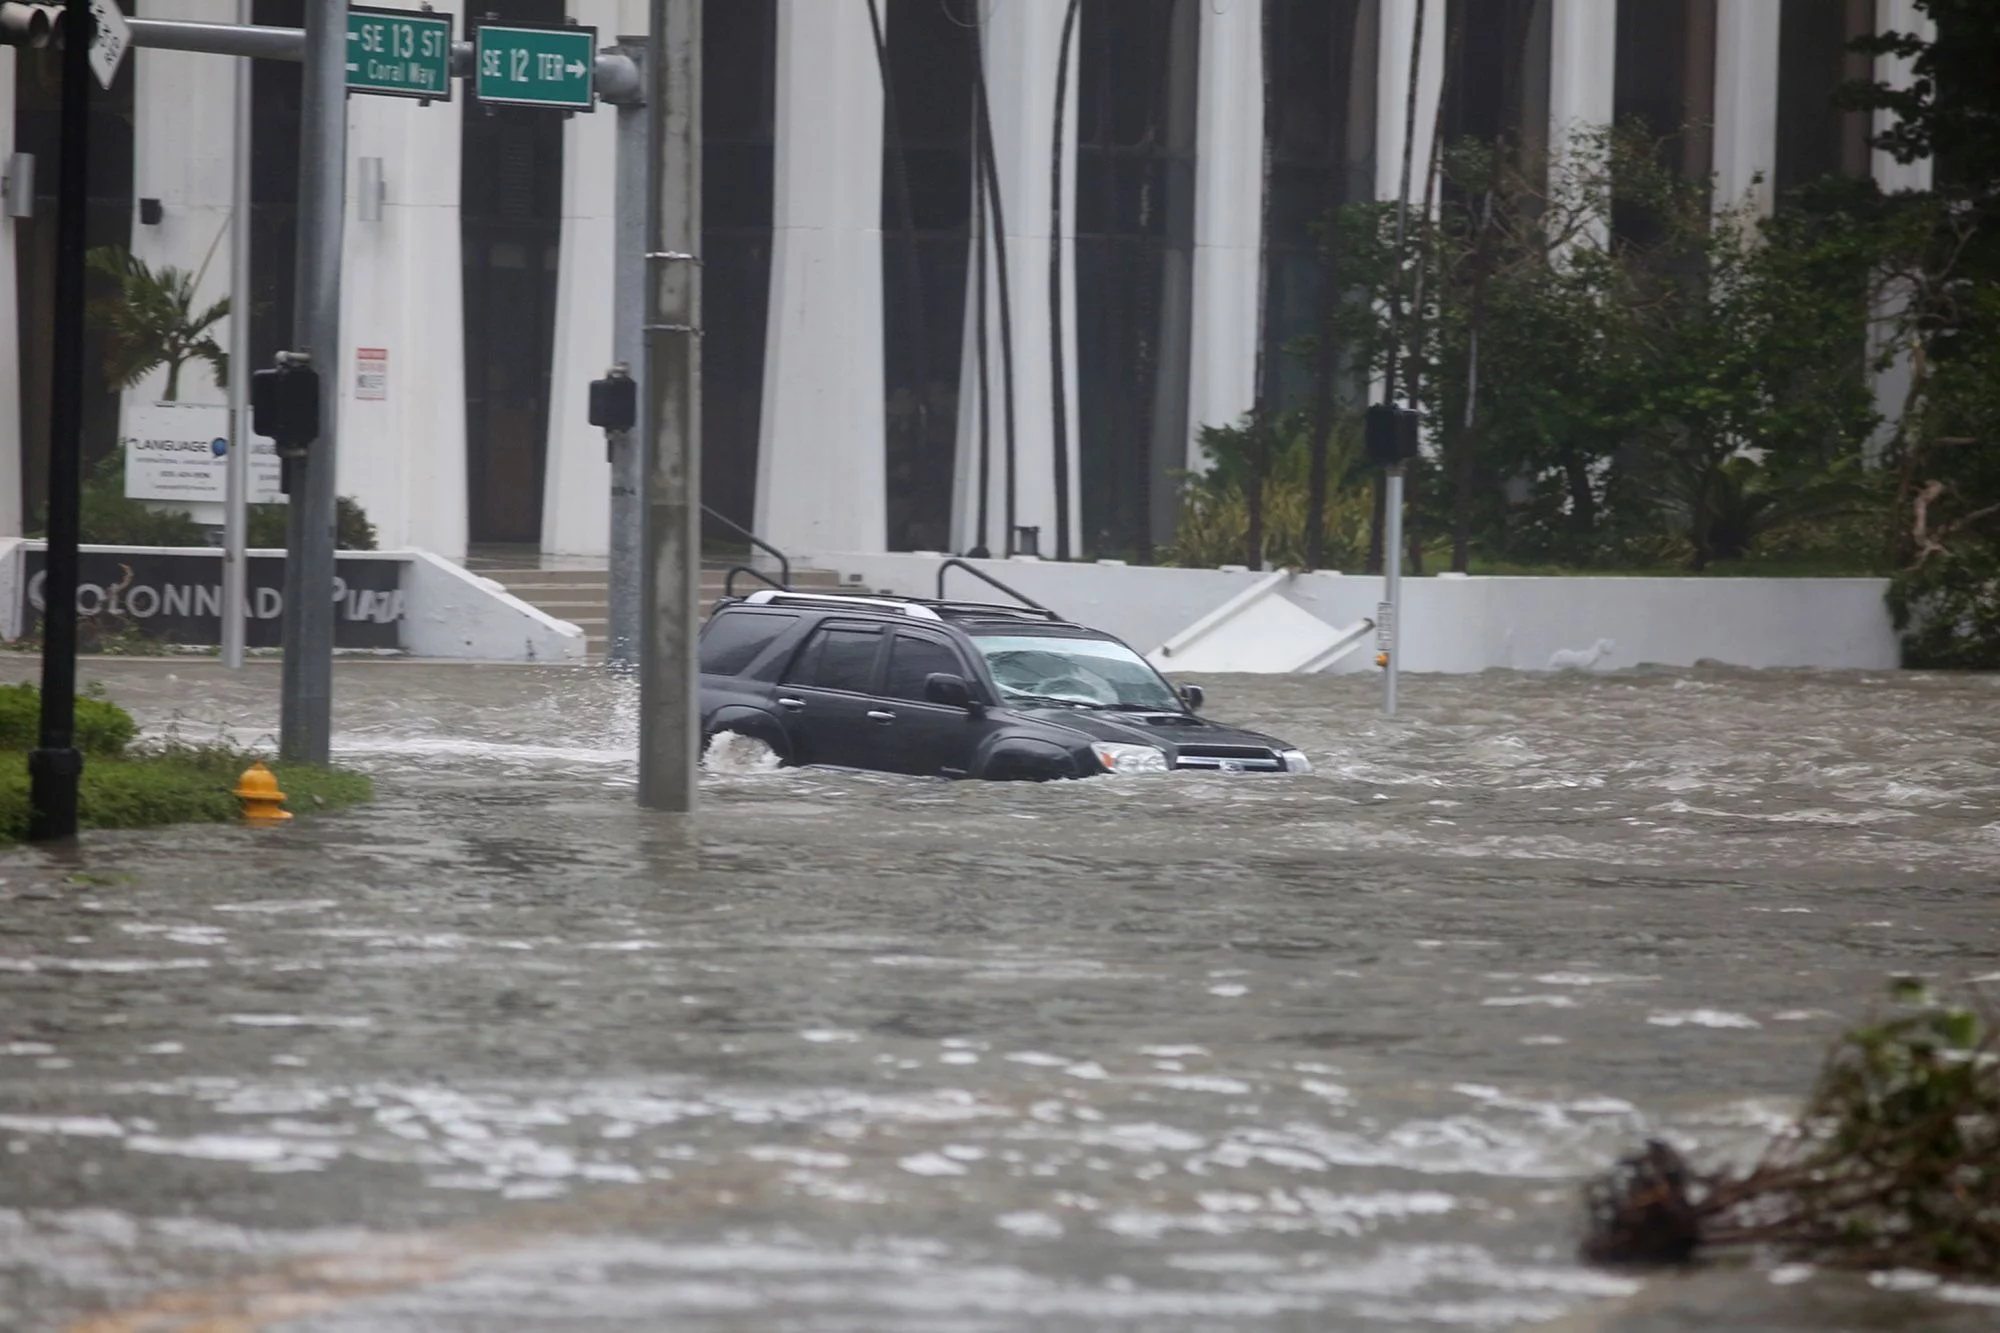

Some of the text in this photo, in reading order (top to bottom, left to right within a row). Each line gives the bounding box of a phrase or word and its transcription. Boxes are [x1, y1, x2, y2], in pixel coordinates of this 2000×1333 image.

[361, 24, 444, 58] SE 13 ST
[367, 59, 437, 90] Coral Way
[482, 48, 564, 82] SE 12 TER
[135, 439, 209, 453] LANGUAGE
